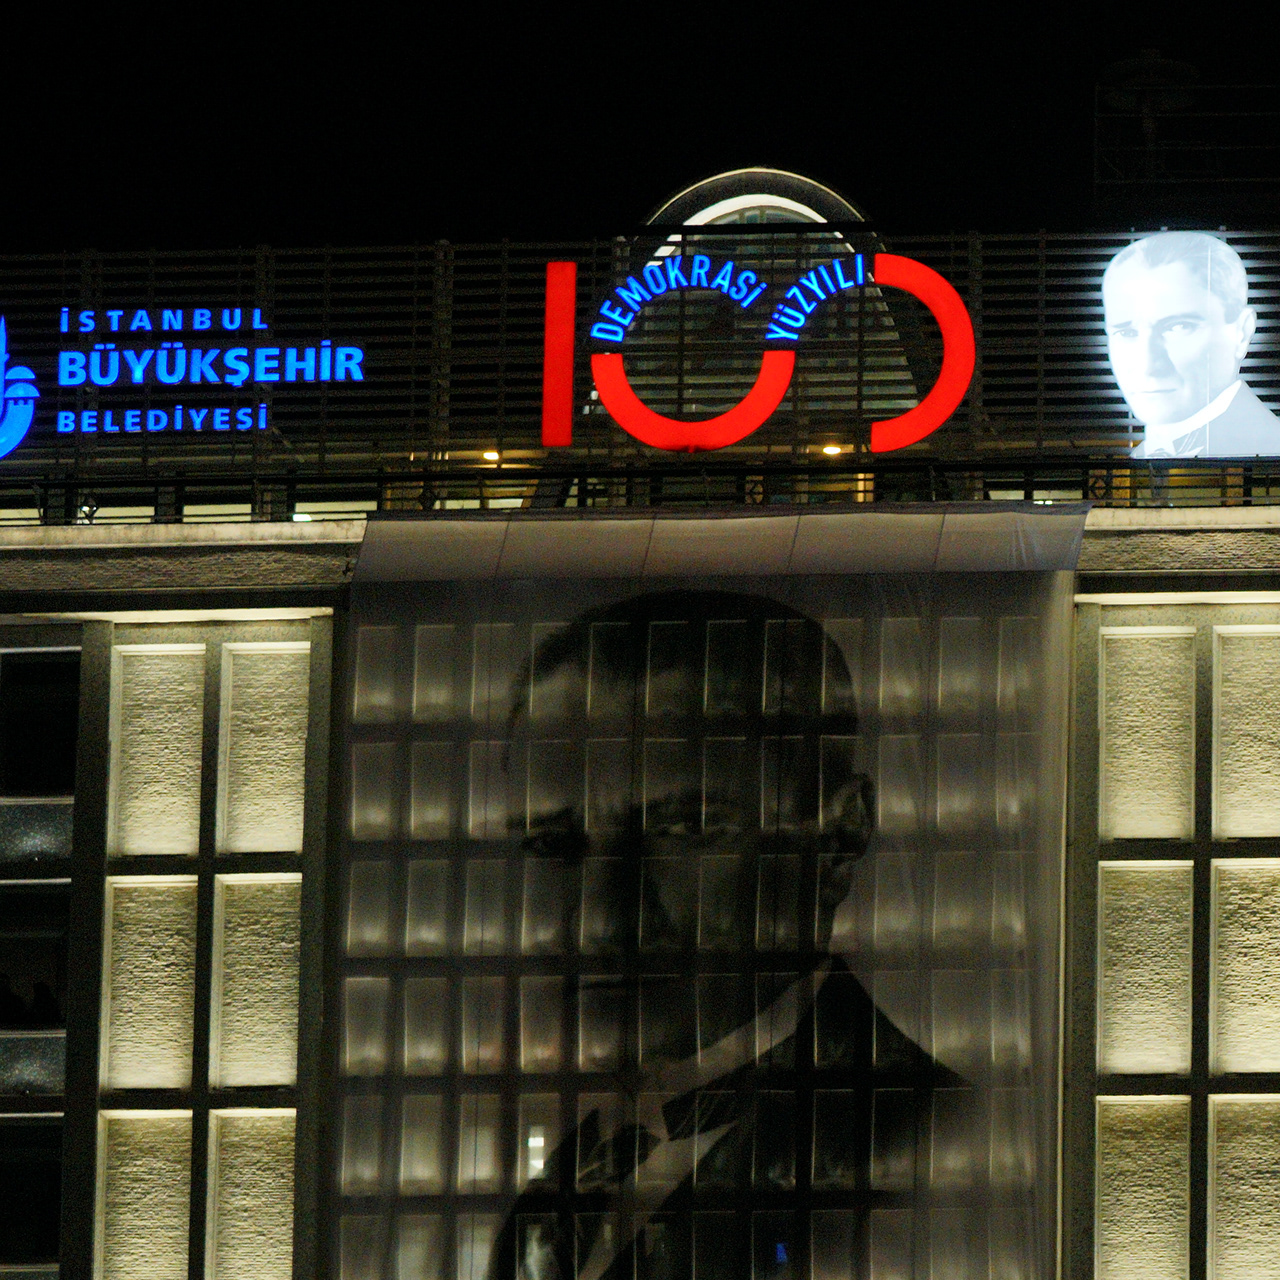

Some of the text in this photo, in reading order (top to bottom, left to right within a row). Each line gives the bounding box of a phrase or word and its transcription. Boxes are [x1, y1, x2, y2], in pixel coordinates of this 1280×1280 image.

[590, 253, 866, 344] DEMOKRASİ YÜZYILI
[59, 306, 269, 333] İSTANBUL
[57, 339, 365, 388] BÜYÜKŞEHİR
[56, 403, 268, 433] BELEDİYESİ
